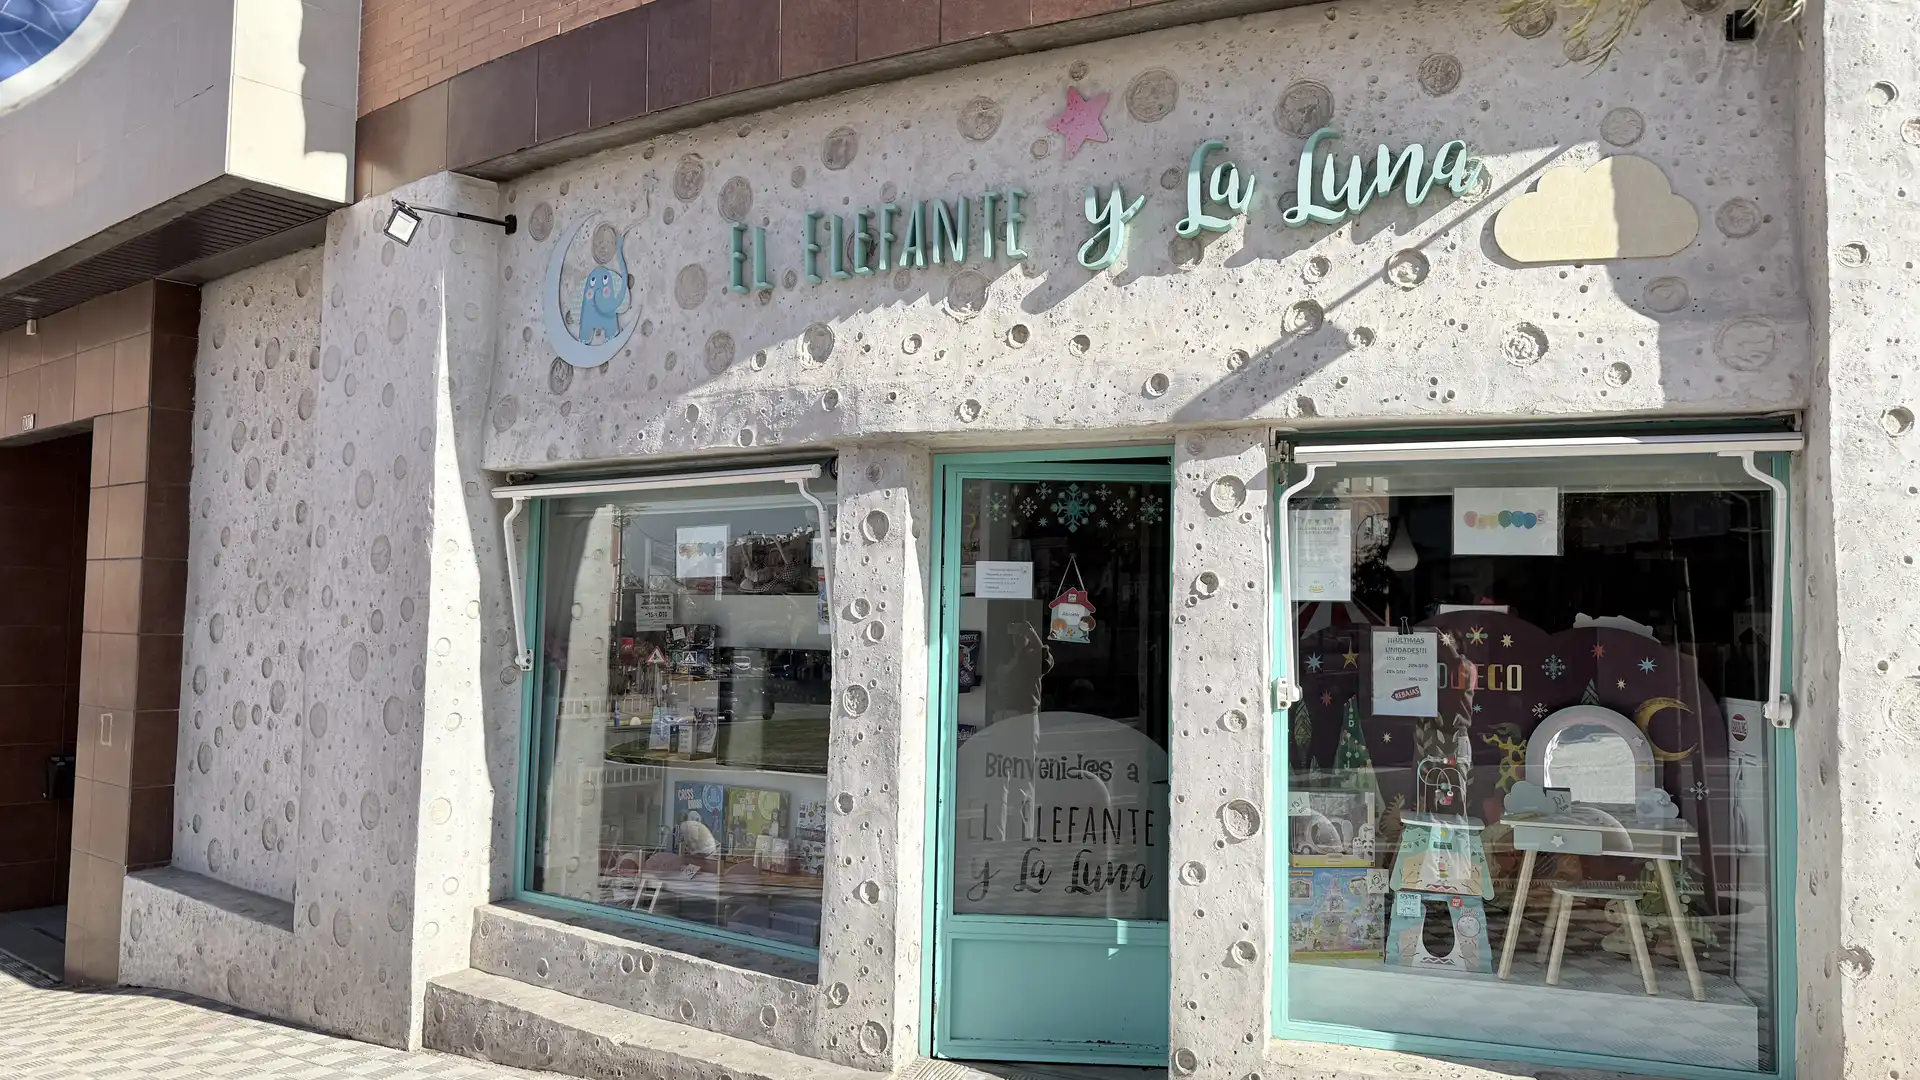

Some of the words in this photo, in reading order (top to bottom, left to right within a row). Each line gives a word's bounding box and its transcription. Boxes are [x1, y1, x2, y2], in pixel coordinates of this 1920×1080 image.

[729, 221, 775, 294] EL
[803, 186, 1029, 284] ELEFANTE
[1077, 182, 1145, 271] y
[1175, 140, 1255, 238] La
[1282, 127, 1483, 228] Luna
[1394, 687, 1420, 699] REBAJAS
[985, 751, 1113, 782] Bienvenid@s
[1127, 762, 1140, 783] a
[1013, 847, 1052, 894] La
[1064, 849, 1154, 895] Luna
